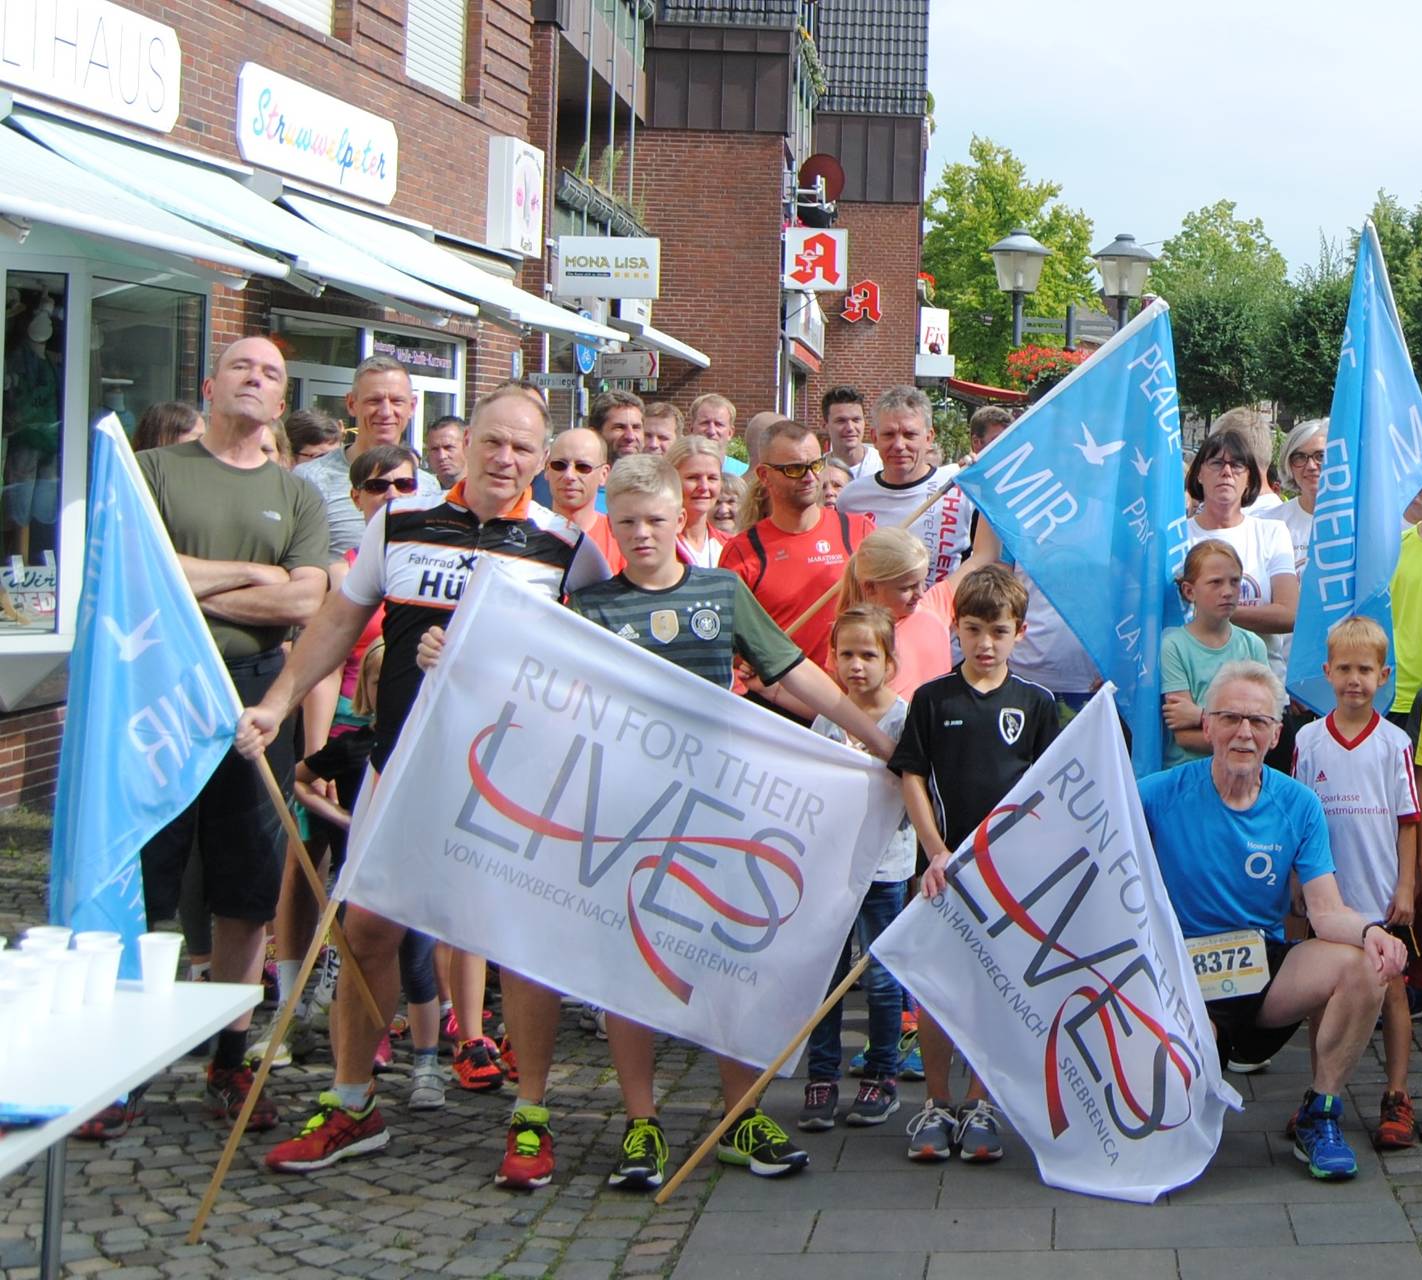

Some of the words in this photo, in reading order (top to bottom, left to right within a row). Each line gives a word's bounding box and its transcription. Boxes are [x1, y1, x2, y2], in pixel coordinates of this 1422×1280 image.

[253, 88, 386, 184] Struwwelpeter
[565, 255, 611, 269] MONA
[614, 256, 650, 270] LISA
[924, 326, 946, 345] Eis
[935, 484, 963, 584] CHALLEN
[983, 441, 1079, 545] MIR
[408, 553, 456, 569] Fahrrad
[511, 653, 617, 732] RUN
[616, 703, 706, 777] FOR
[709, 748, 826, 837] THEIR
[454, 700, 808, 954] LIVES
[1047, 757, 1119, 854] RUN
[1107, 849, 1152, 946] FO
[1244, 851, 1278, 887] O2
[441, 838, 482, 871] VON
[484, 857, 575, 909] HAVIXBECK
[575, 896, 628, 932] NACH
[651, 930, 760, 987] SREBRENICA
[930, 889, 952, 921] ON
[946, 909, 1016, 1001] HAVIXBECK
[1008, 992, 1049, 1039] NACH
[946, 790, 1201, 1141] LIVES
[1192, 945, 1254, 976] 8372
[1058, 1055, 1121, 1168] SREBRENICA
